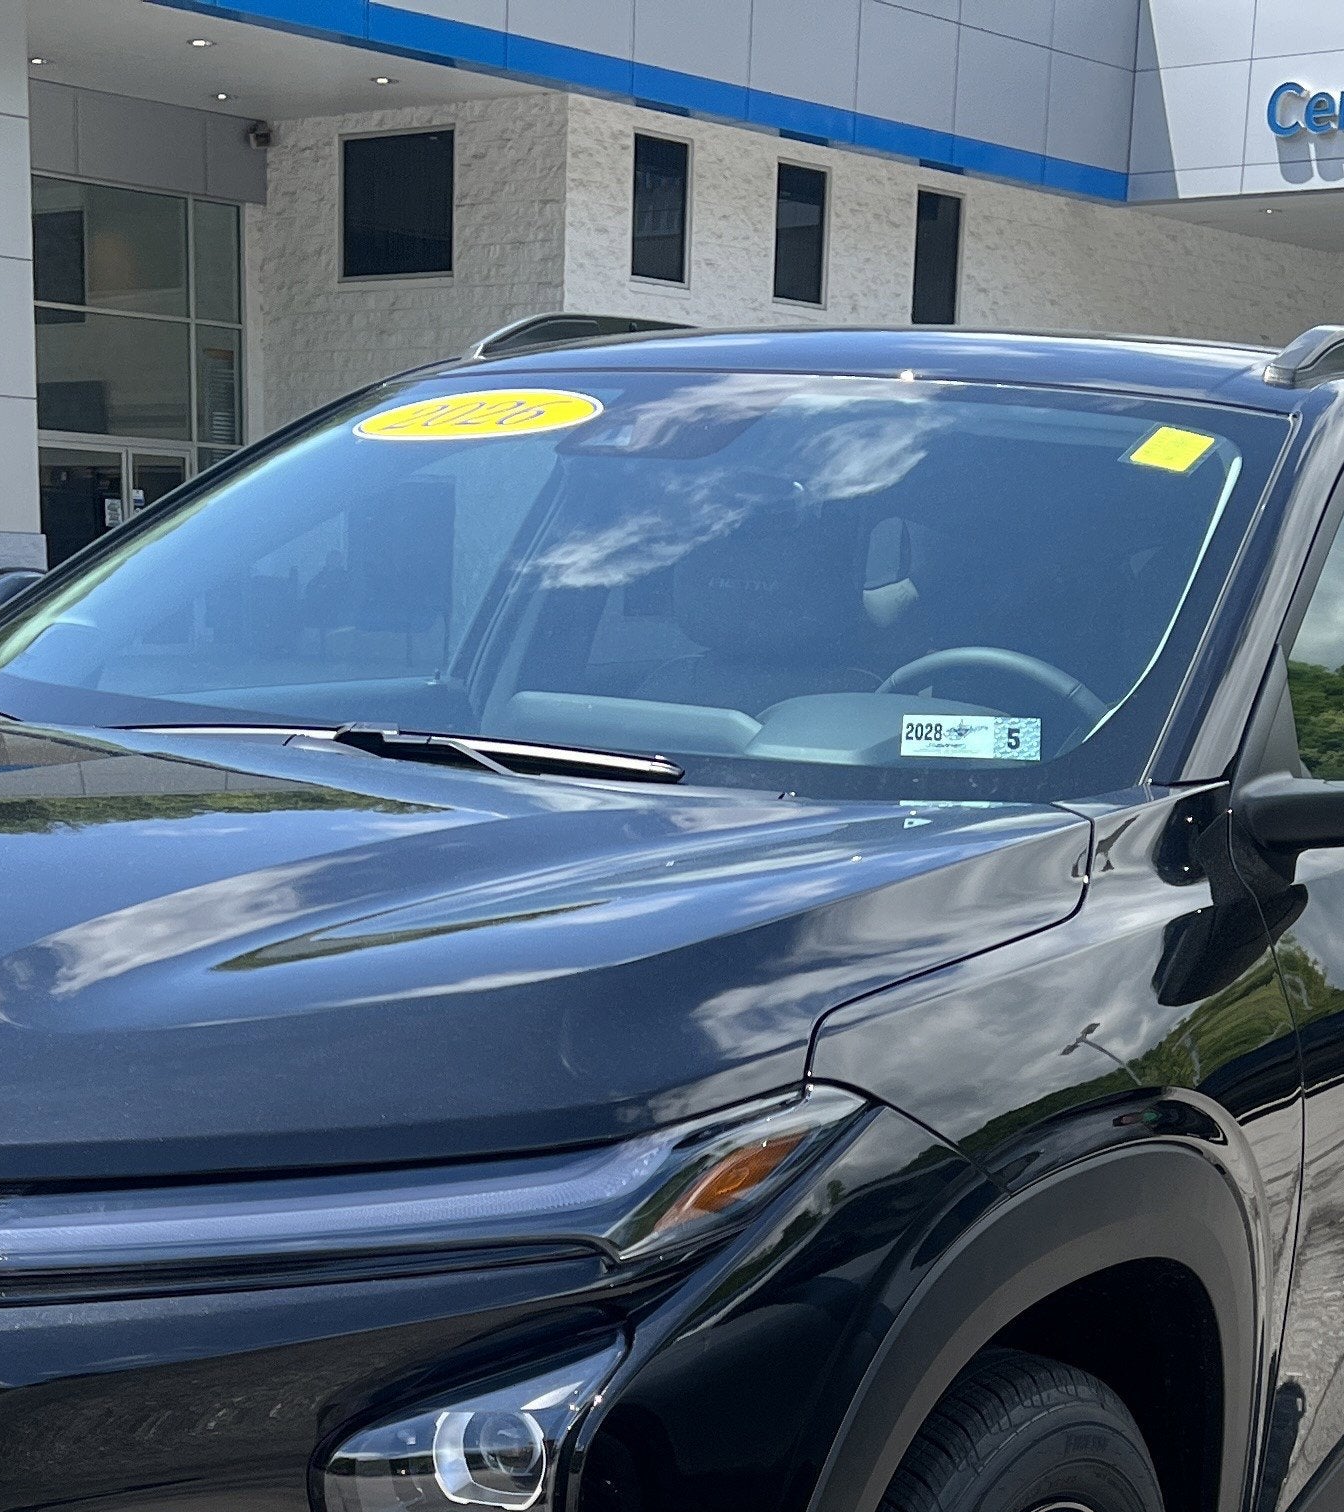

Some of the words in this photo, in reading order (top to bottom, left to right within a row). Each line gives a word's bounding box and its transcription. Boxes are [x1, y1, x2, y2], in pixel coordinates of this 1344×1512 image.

[379, 399, 573, 431] 2026
[906, 722, 943, 742] 2028
[1007, 727, 1021, 750] 5
